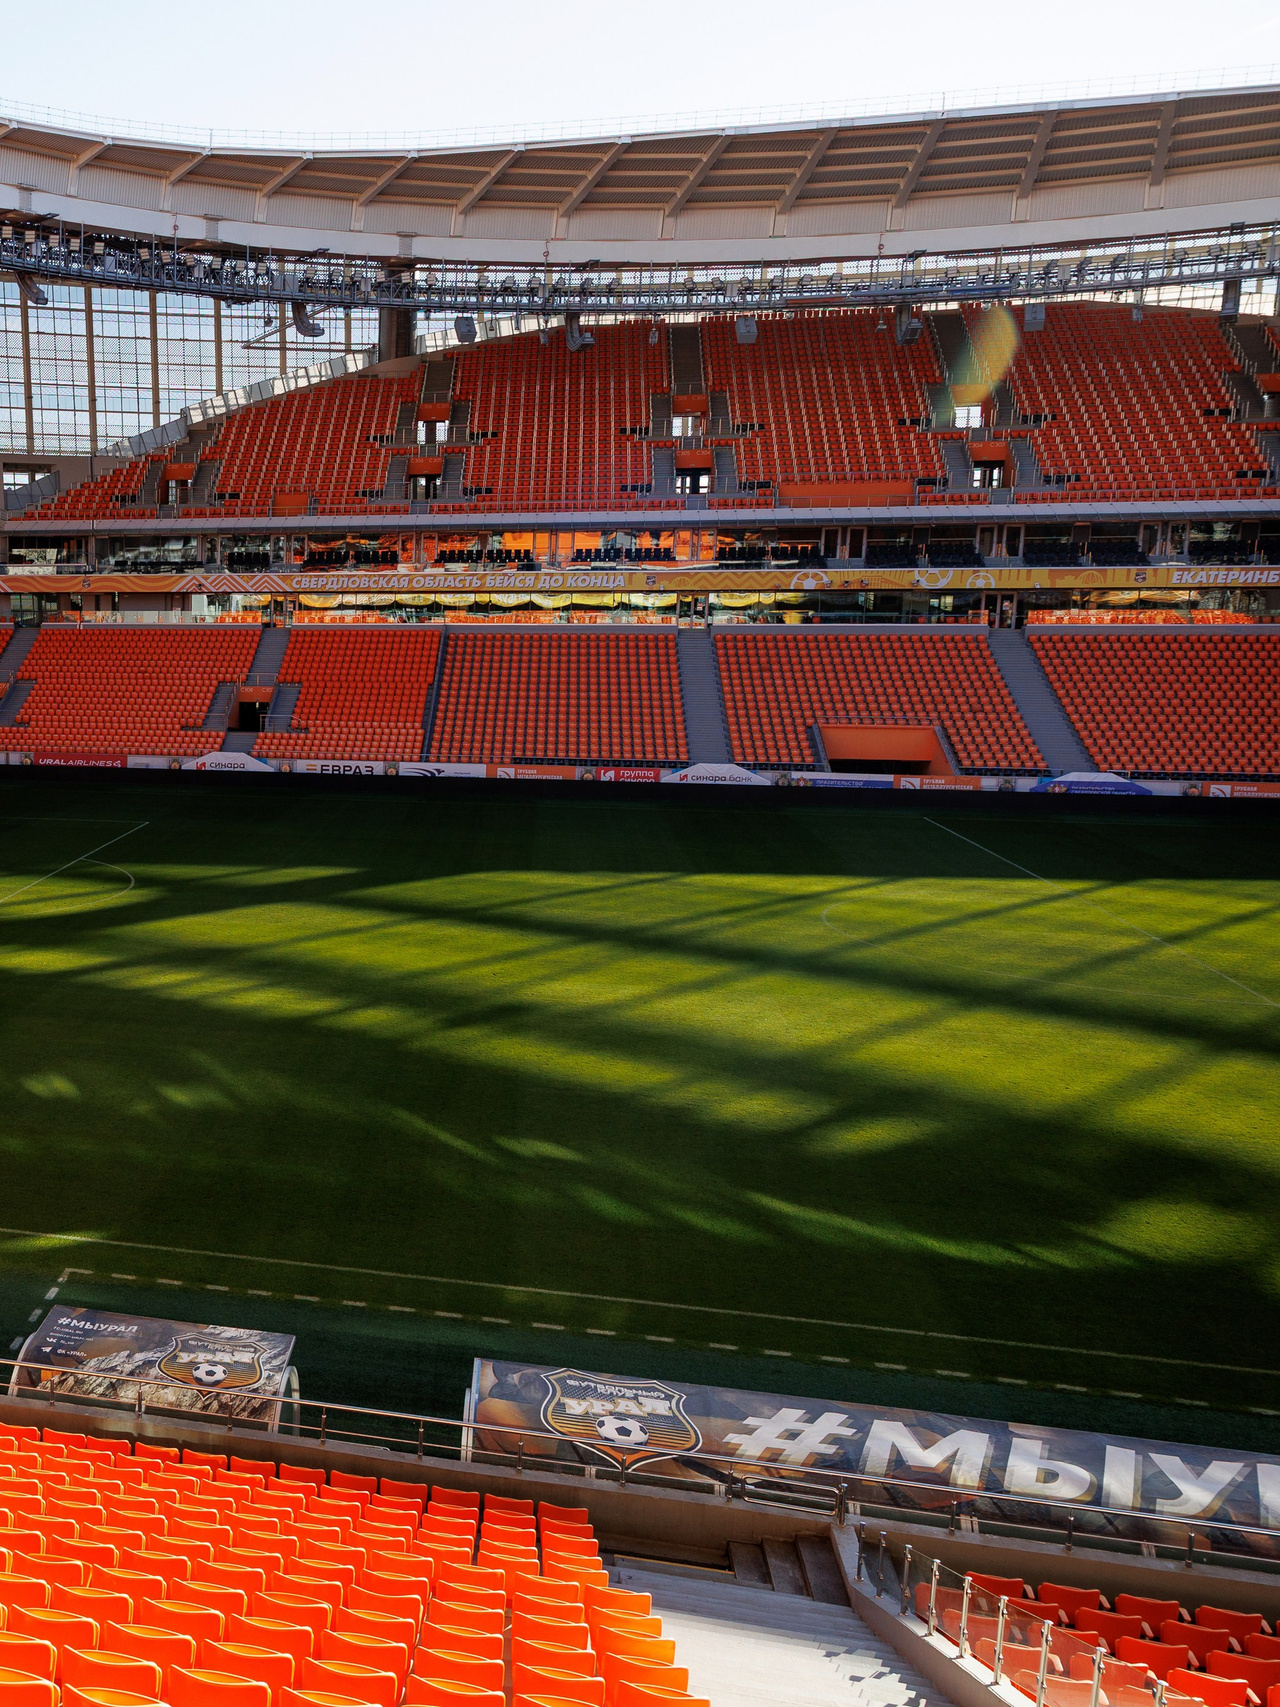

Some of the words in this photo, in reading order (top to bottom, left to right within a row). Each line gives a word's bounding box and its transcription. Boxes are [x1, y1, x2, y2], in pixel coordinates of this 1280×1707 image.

[292, 575, 409, 590] СВЕРДЛОВСКАЯ
[416, 575, 481, 589] ОБЛАСТЬ
[485, 572, 535, 588] БЕЙСЯ
[538, 575, 563, 589] ДО
[566, 574, 625, 589] КОНЦА
[1171, 571, 1280, 584] ЕКАТЕРИНБ
[209, 761, 246, 770] синара
[320, 764, 374, 775] ЕВРАЗ
[620, 769, 654, 778] группа
[690, 774, 727, 783] синара
[728, 773, 753, 783] банк
[57, 1317, 138, 1333] #МЫУРАЛ
[176, 1351, 256, 1364] УРАЛ
[560, 1396, 673, 1417] УРАЛ
